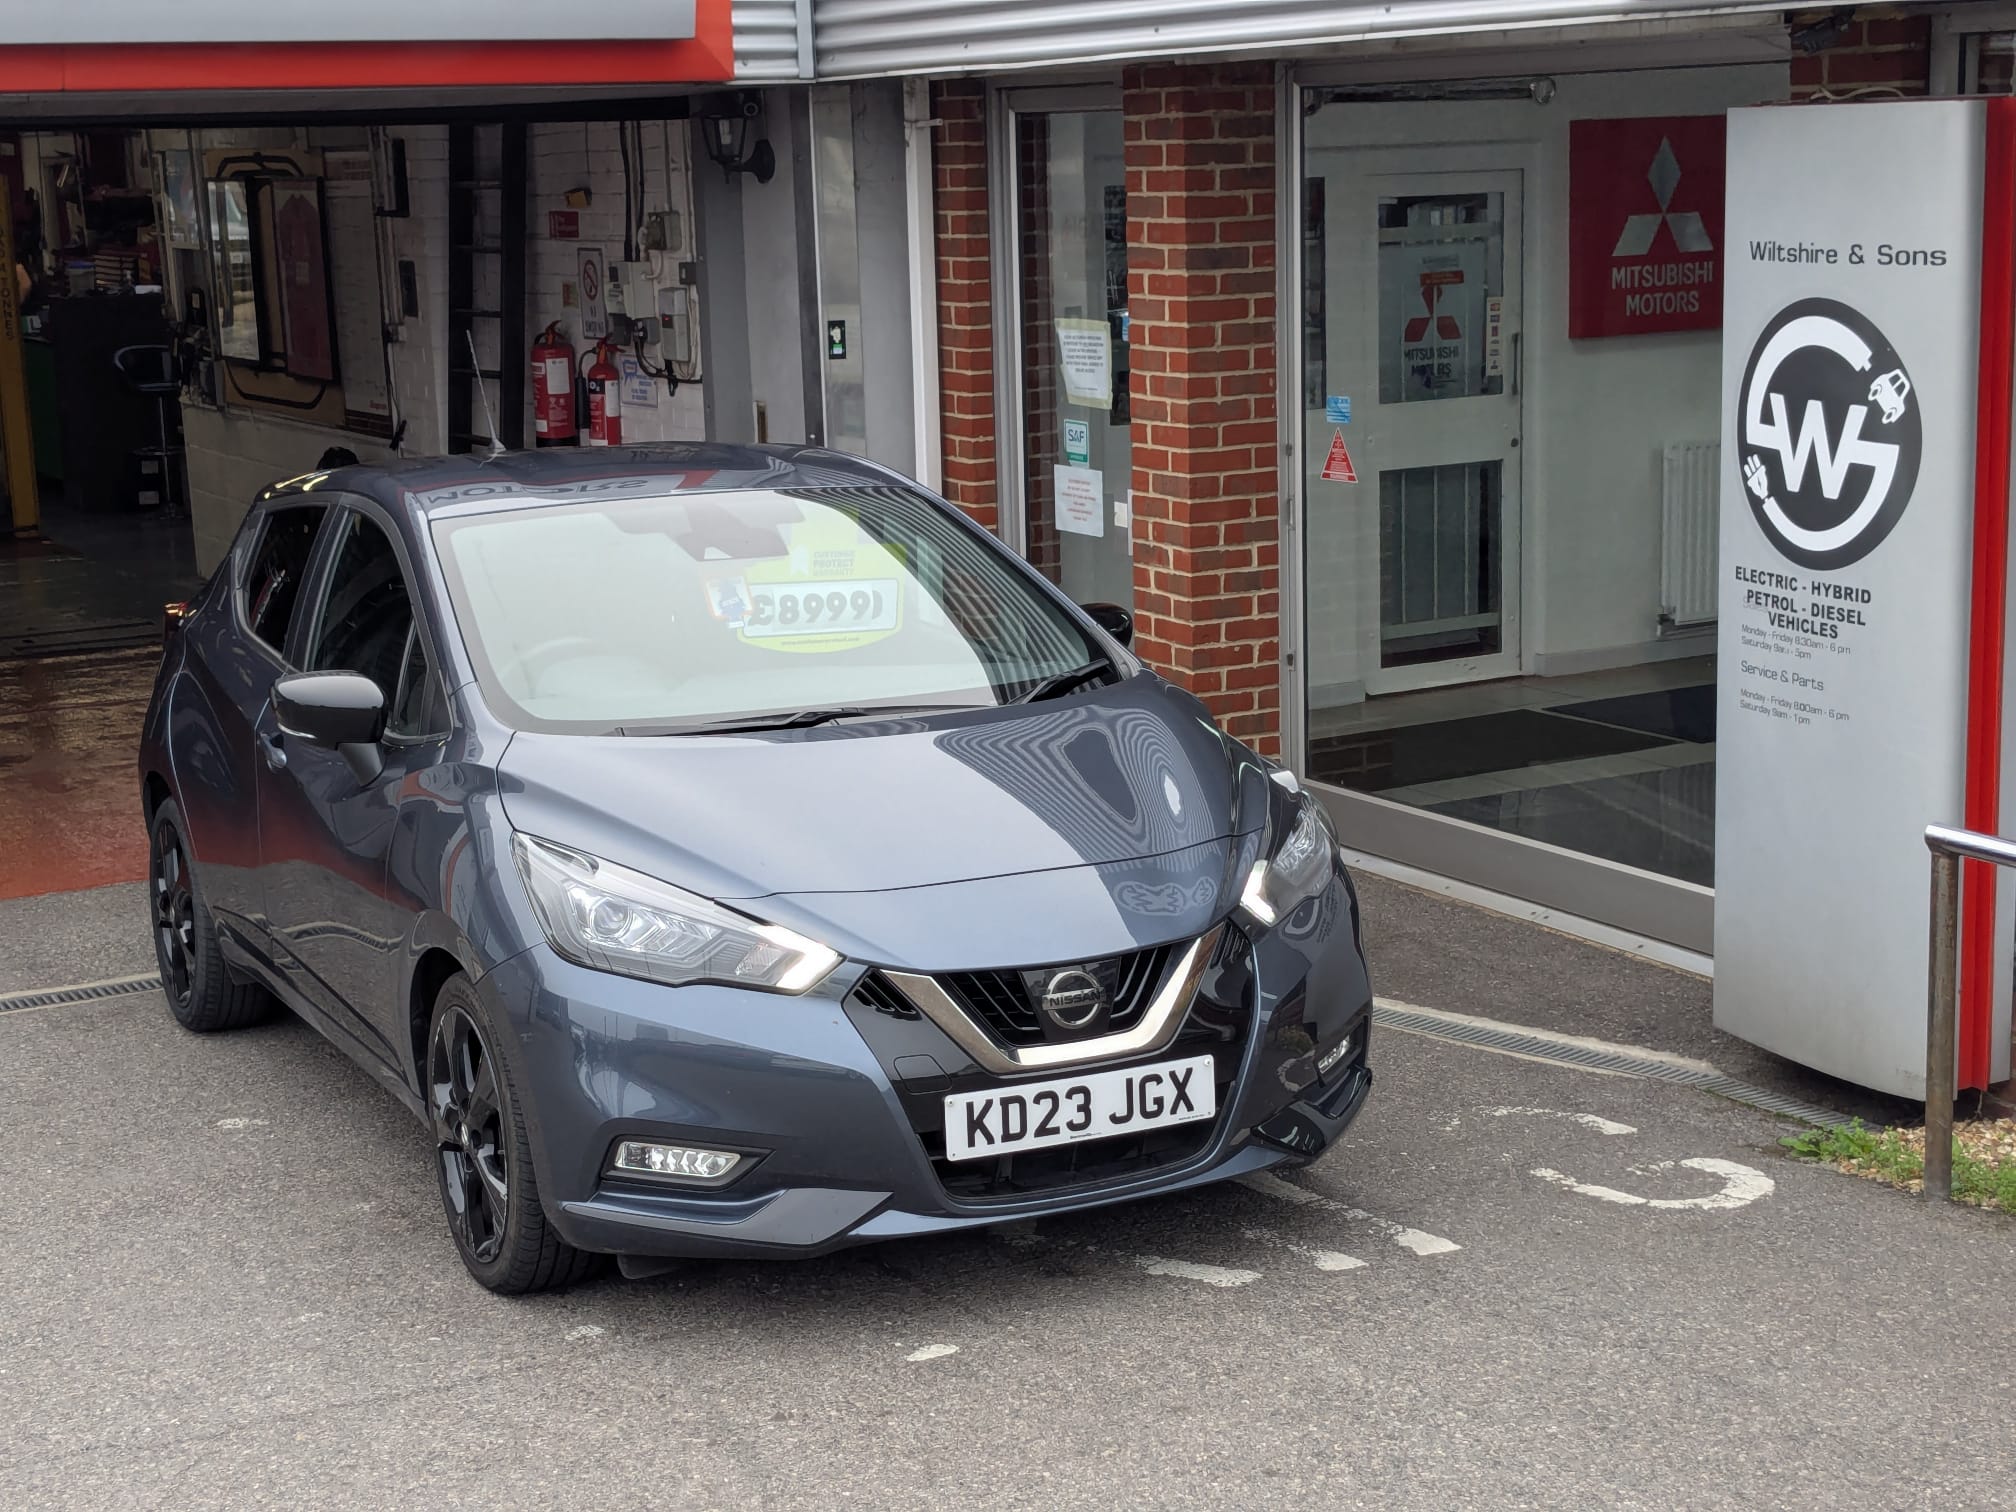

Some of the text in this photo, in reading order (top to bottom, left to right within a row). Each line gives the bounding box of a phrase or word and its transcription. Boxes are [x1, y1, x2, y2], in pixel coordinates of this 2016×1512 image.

[1749, 240, 1948, 267] Wiltshire & Sons
[1611, 261, 1714, 290] MITSUBISHI
[1625, 290, 1700, 317] MOTORS
[1403, 345, 1459, 362] MITSUISHI
[1735, 565, 1798, 592] ELECTRIC
[1811, 580, 1872, 604] HYBRID
[1746, 589, 1798, 613] PETROL
[1811, 602, 1866, 626] DIESEL
[1741, 624, 1766, 639] Monday
[1771, 631, 1793, 646] Friday
[1767, 611, 1838, 639] VEHICLES
[1741, 636, 1772, 653] Saturday
[1794, 648, 1812, 660] 5pm
[1740, 660, 1824, 691] Service & Parts
[1739, 699, 1771, 716] Saturday
[1772, 708, 1788, 720] 9am
[1740, 688, 1766, 703] Monday
[1770, 696, 1792, 709] Friday
[1828, 709, 1835, 718] 6
[1835, 712, 1850, 721] pm
[1046, 987, 1101, 1007] NISSAN
[965, 1067, 1195, 1149] KD23 JGX
